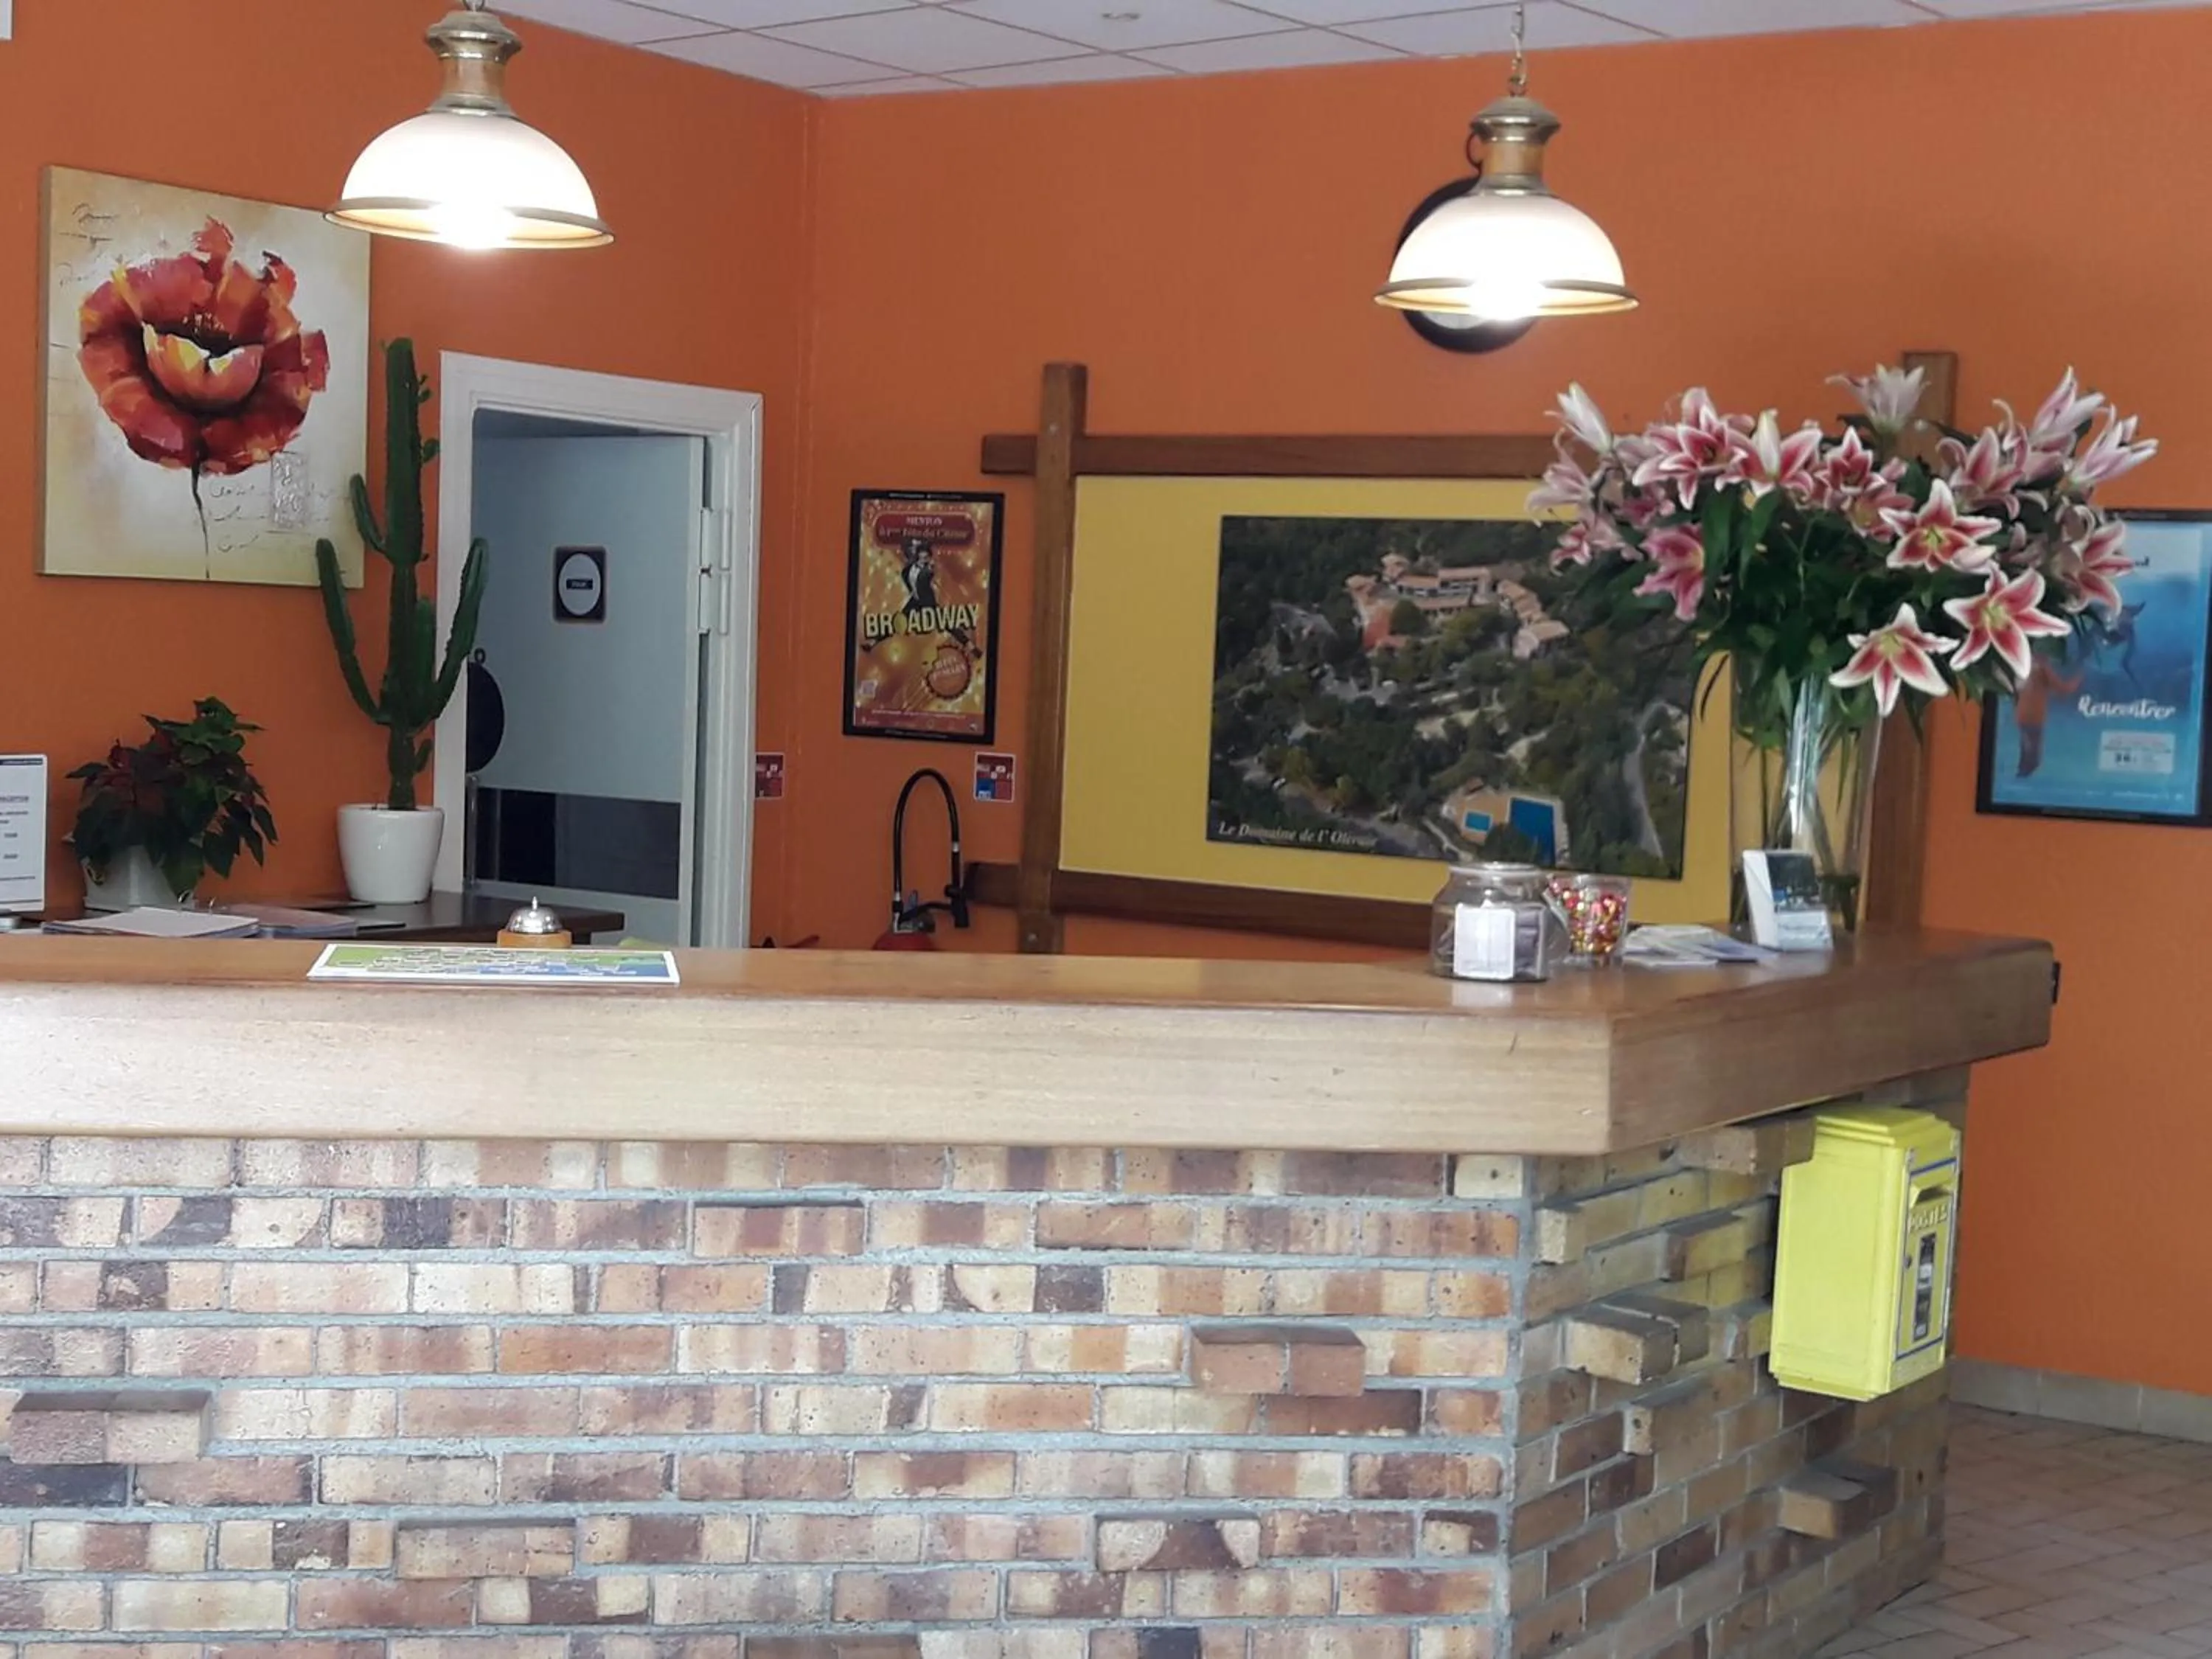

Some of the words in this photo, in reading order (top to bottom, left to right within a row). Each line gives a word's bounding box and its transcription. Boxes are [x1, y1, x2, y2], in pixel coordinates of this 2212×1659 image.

[865, 604, 979, 638] BROADWAY
[2078, 694, 2177, 720] Rencontrer
[1218, 820, 1237, 835] Le
[1299, 827, 1315, 841] de
